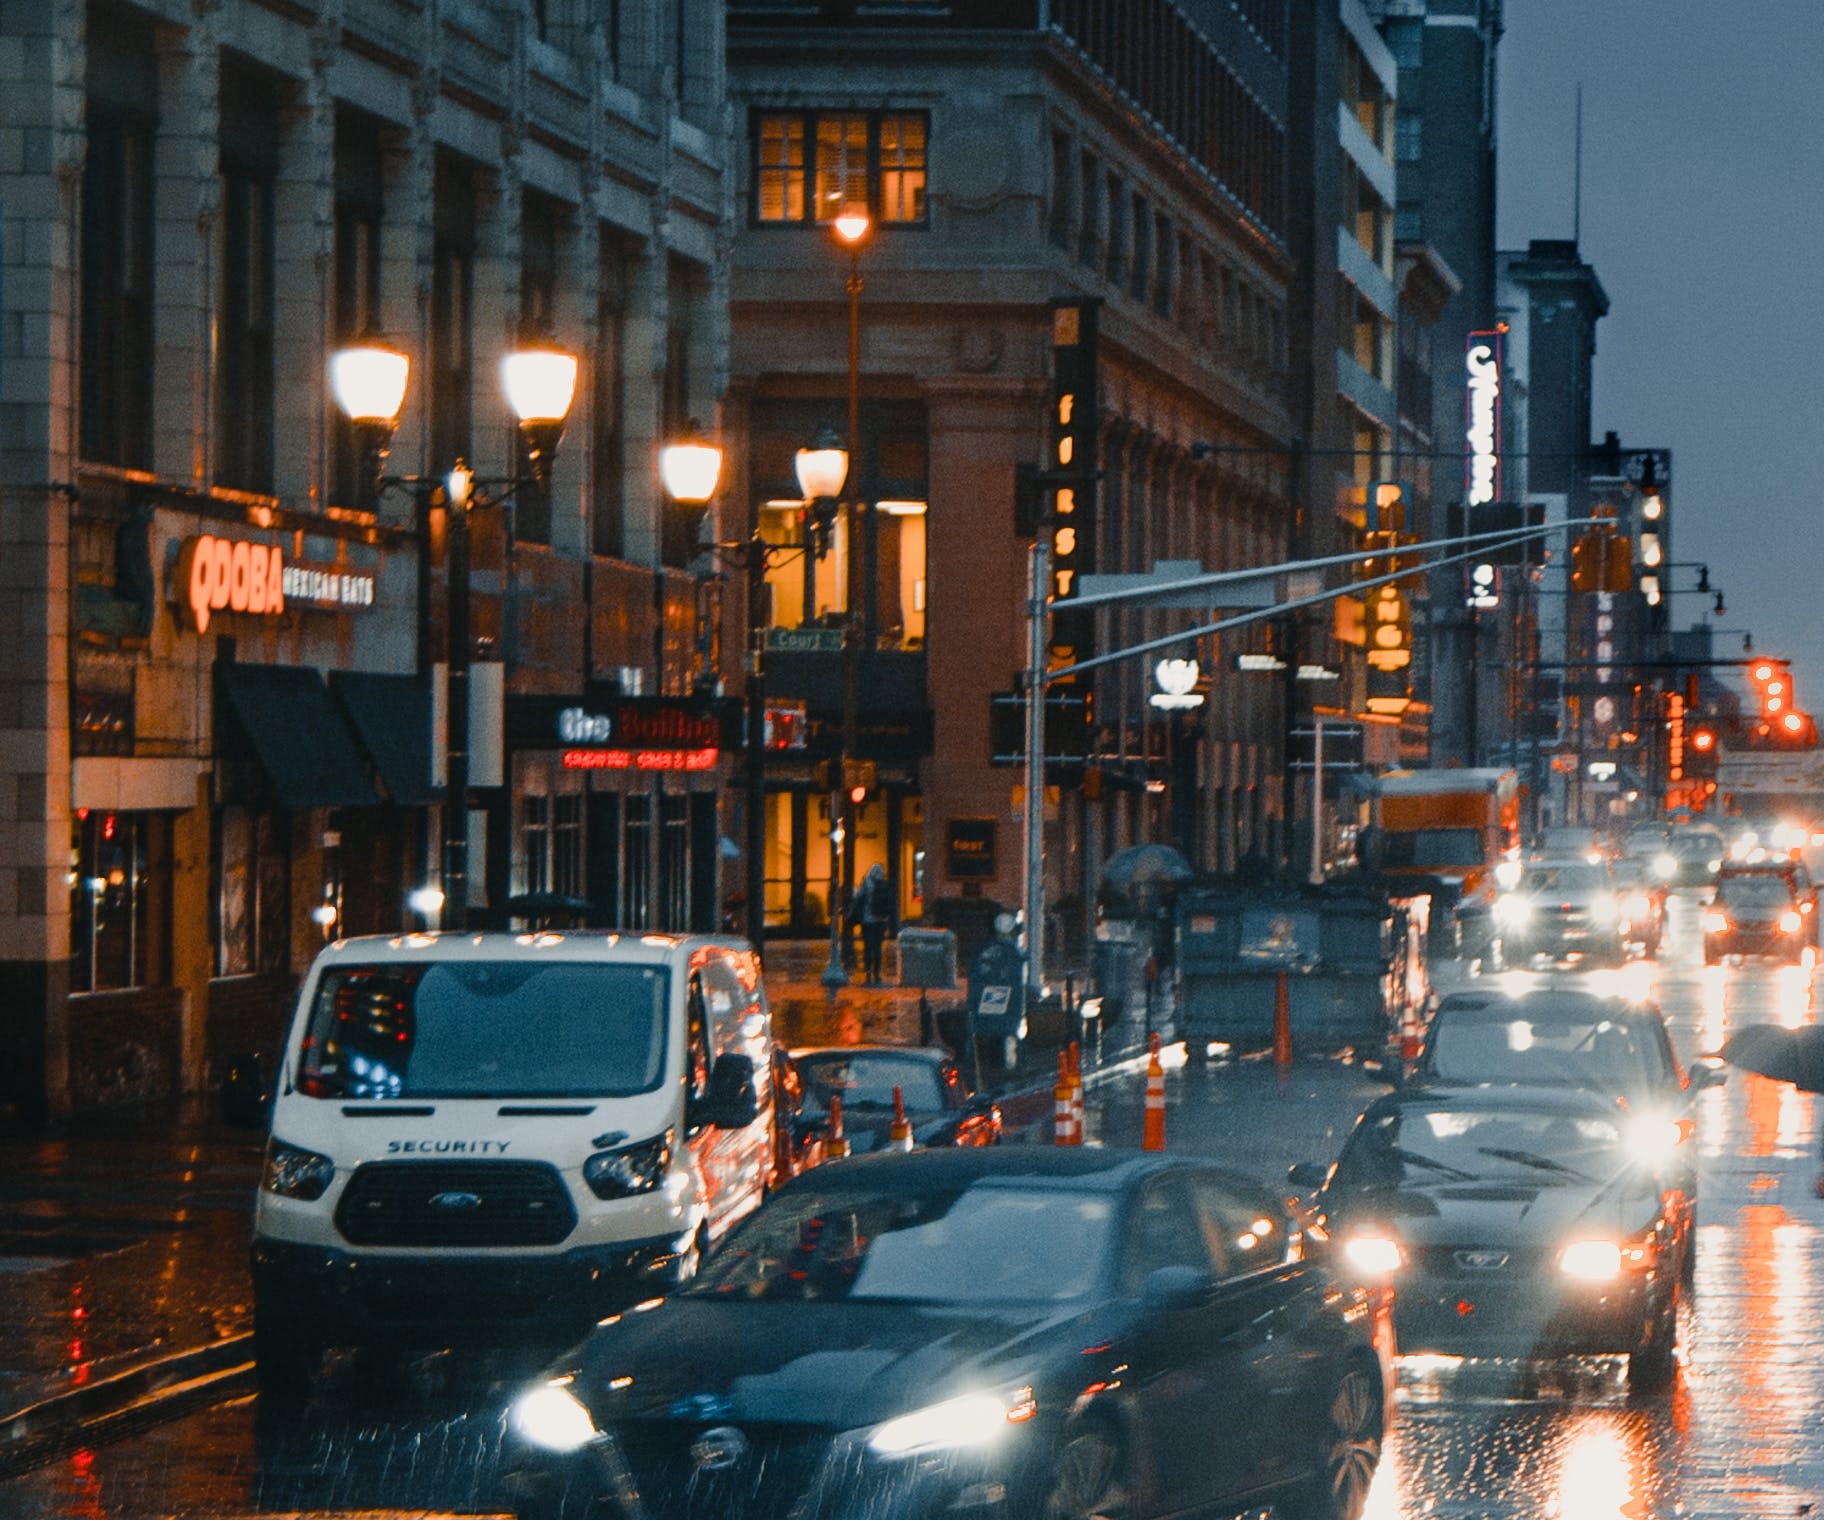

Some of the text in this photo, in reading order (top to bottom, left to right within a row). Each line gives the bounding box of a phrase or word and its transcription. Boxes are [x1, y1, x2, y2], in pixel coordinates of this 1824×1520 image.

[190, 534, 374, 635] QDOBA MEXICAN EATS
[560, 707, 611, 744] the
[387, 1140, 512, 1154] SECURITY
